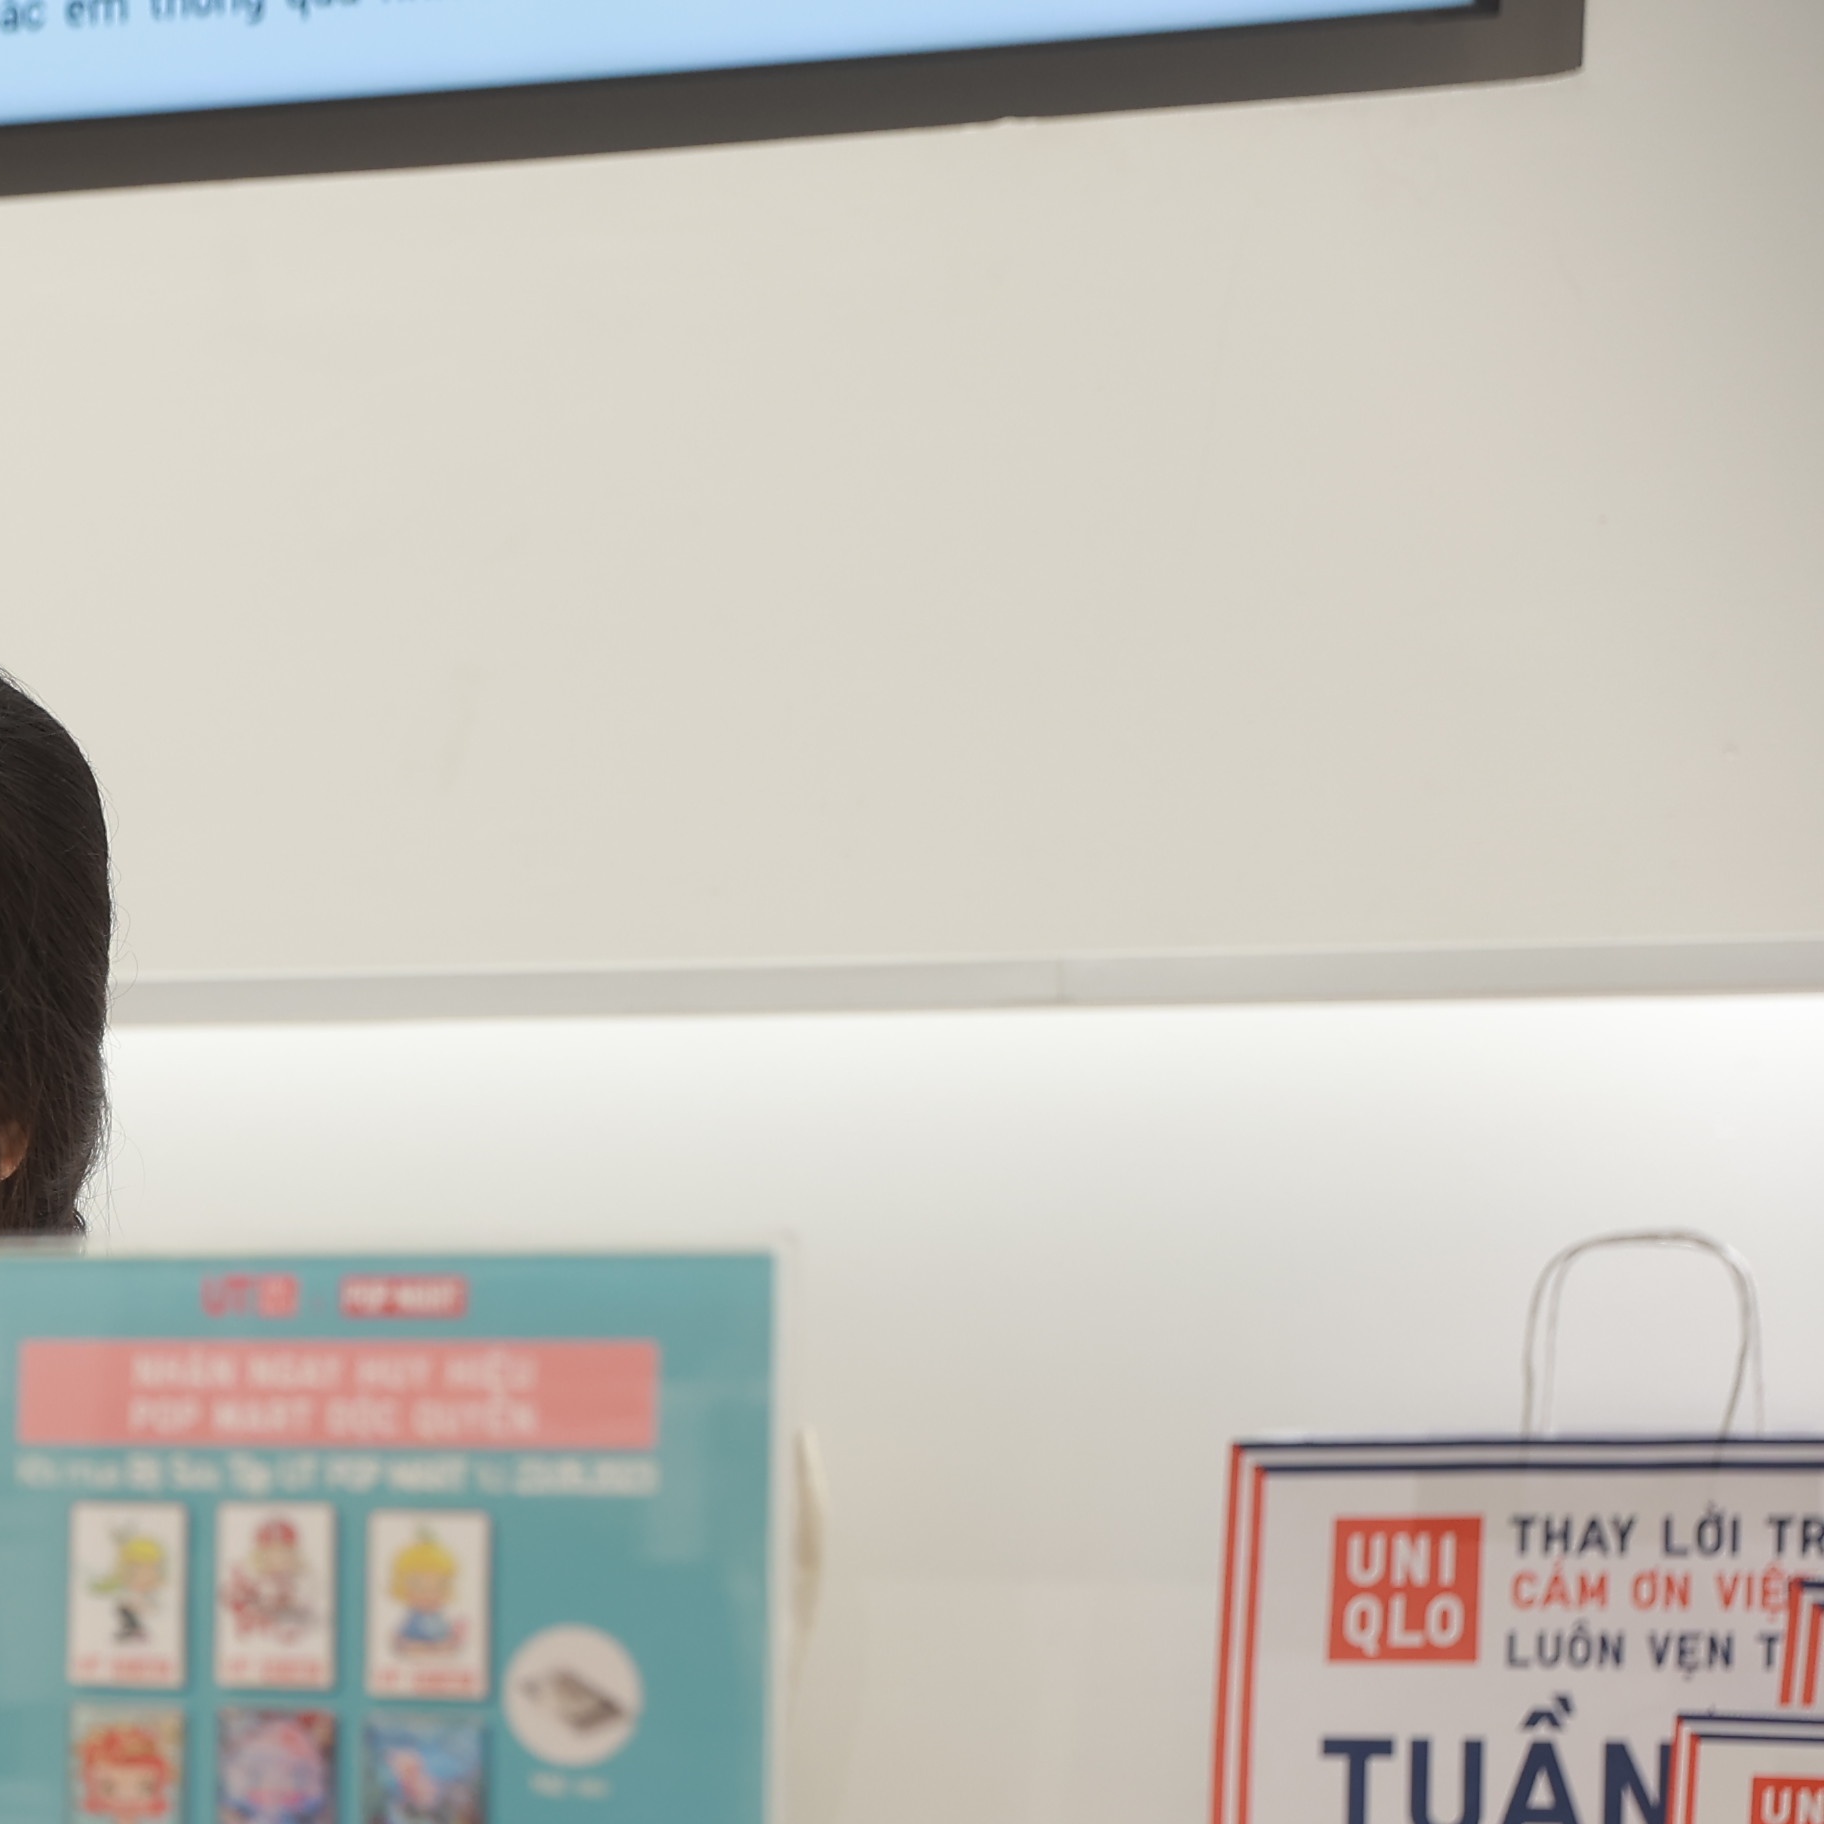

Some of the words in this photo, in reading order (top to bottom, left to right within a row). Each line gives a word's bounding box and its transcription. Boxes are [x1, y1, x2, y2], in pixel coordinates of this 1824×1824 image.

[1346, 1532, 1458, 1588] UNI
[1510, 1514, 1636, 1556] THAY
[1767, 1515, 1824, 1556] TR
[1510, 1557, 1610, 1611] CẢM
[1633, 1570, 1691, 1611] ƠN
[1716, 1564, 1789, 1623] VIỆ
[1343, 1593, 1464, 1656] QLO
[1505, 1620, 1624, 1668] LUÔN
[1645, 1631, 1734, 1681] VẸN
